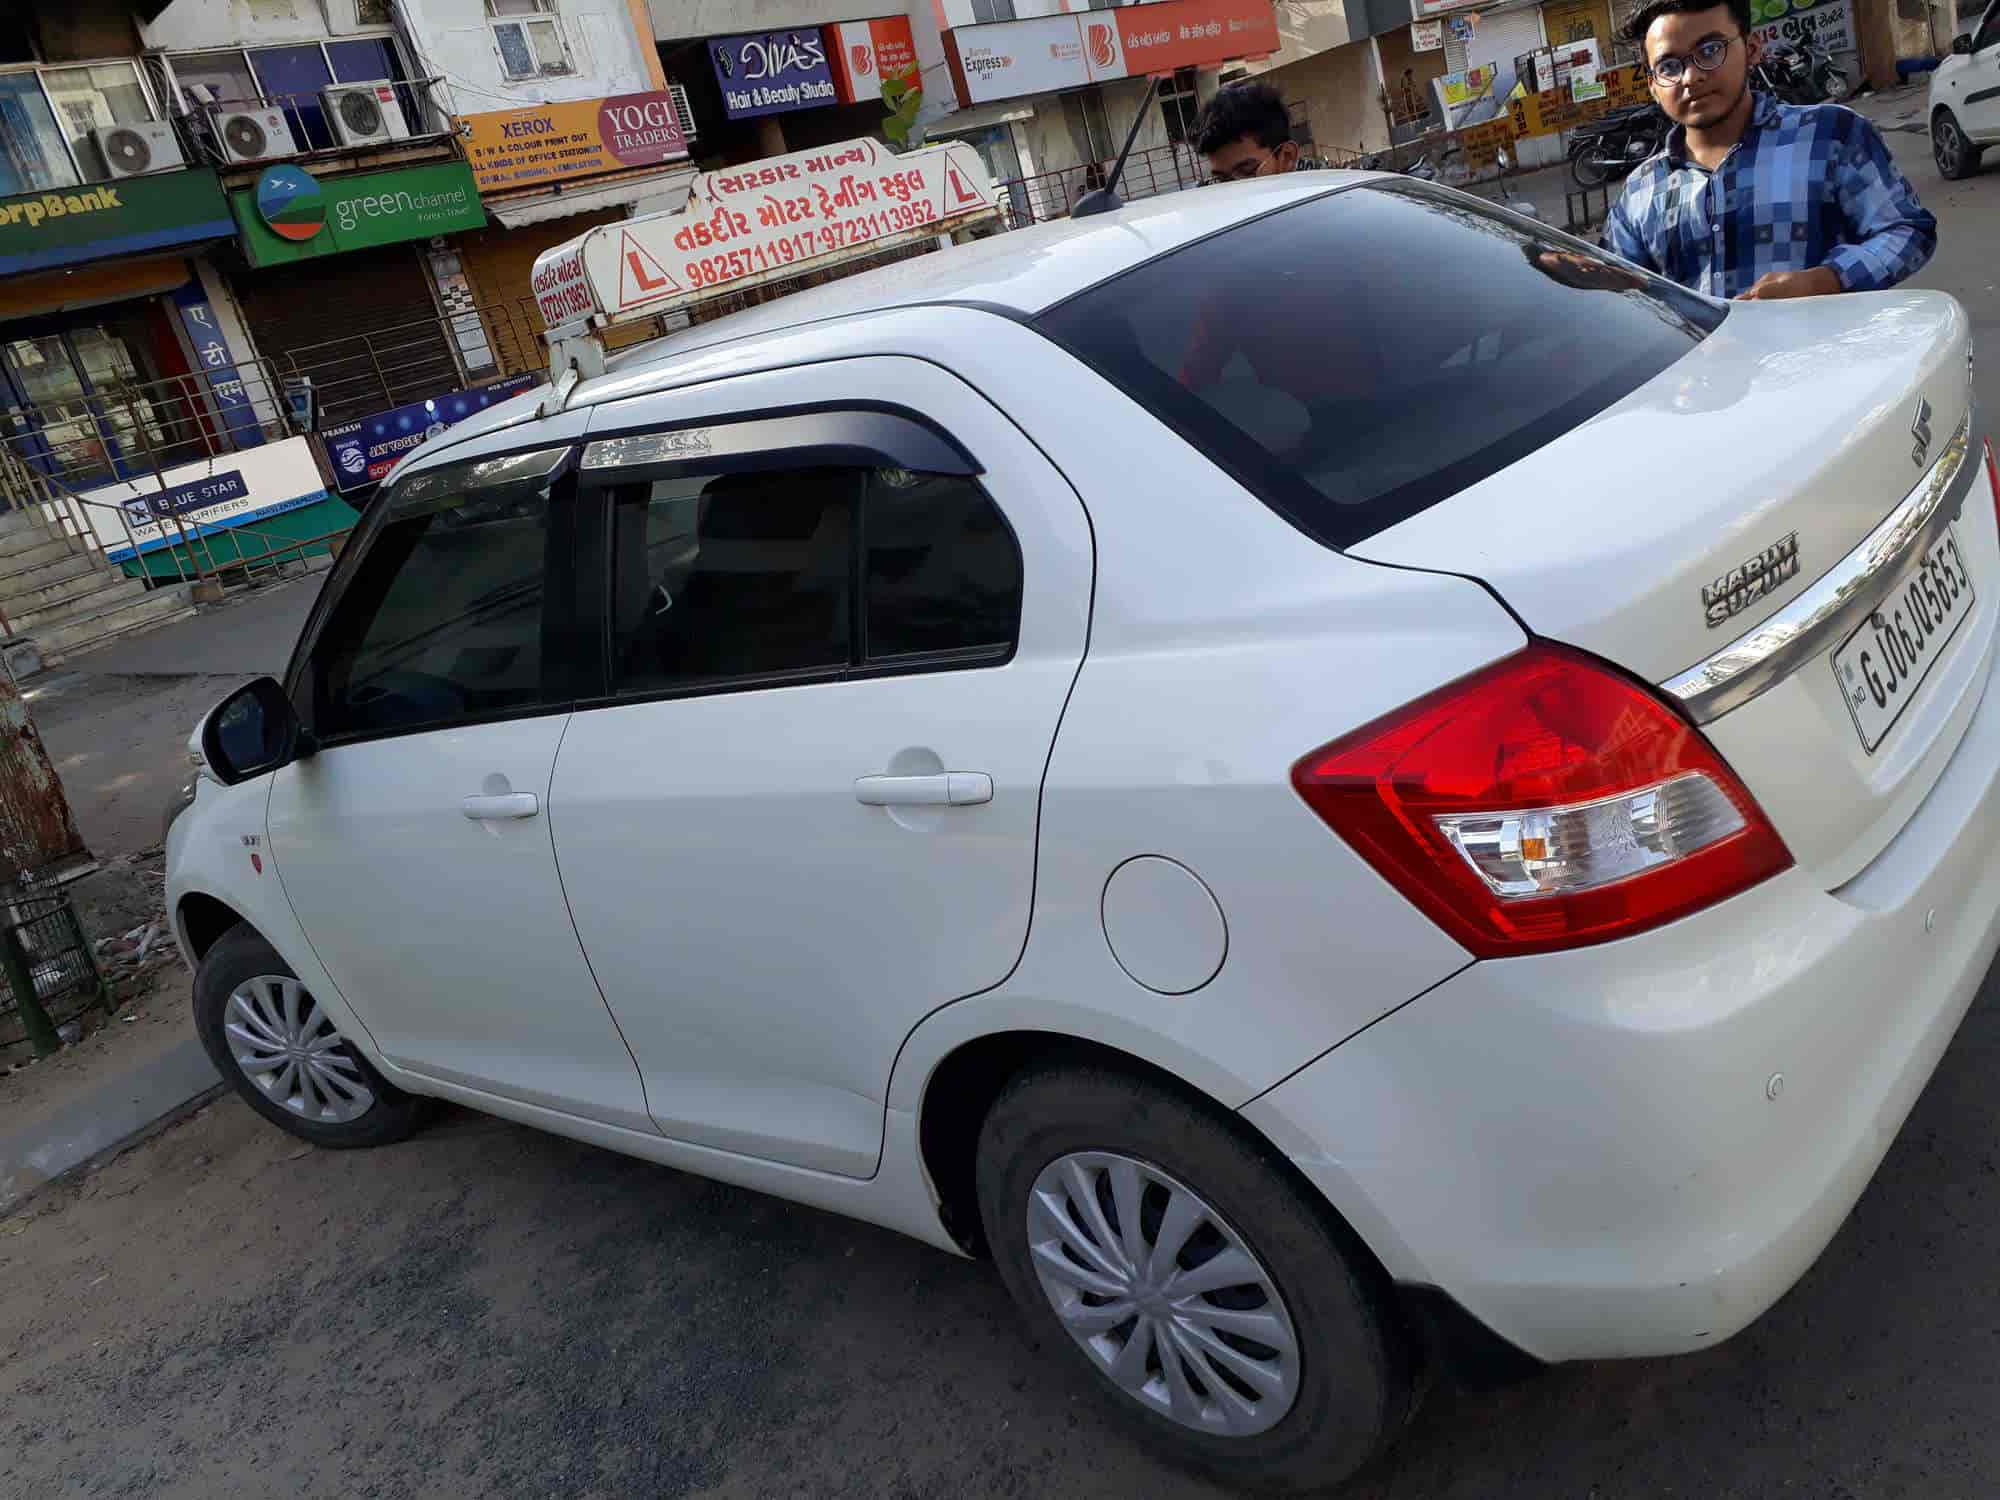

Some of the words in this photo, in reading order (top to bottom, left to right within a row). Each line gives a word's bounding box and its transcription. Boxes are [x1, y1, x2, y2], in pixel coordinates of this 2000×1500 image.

[964, 56, 1001, 74] Express
[726, 90, 751, 110] Hair
[751, 89, 763, 107] &
[763, 84, 800, 105] Beauty
[801, 79, 835, 100] Studio
[500, 118, 556, 139] XEROX
[606, 101, 677, 133] YOGI
[571, 132, 588, 142] OUT
[613, 126, 679, 150] TRADERS
[528, 150, 559, 162] OFFICE
[947, 169, 977, 204] L
[336, 191, 413, 231] green
[413, 183, 467, 209] channel
[756, 194, 816, 227] મોટર
[626, 250, 667, 292] L
[201, 479, 239, 499] STAR
[1701, 528, 1800, 608] MARUTI
[1705, 554, 1801, 629] SUZUKI
